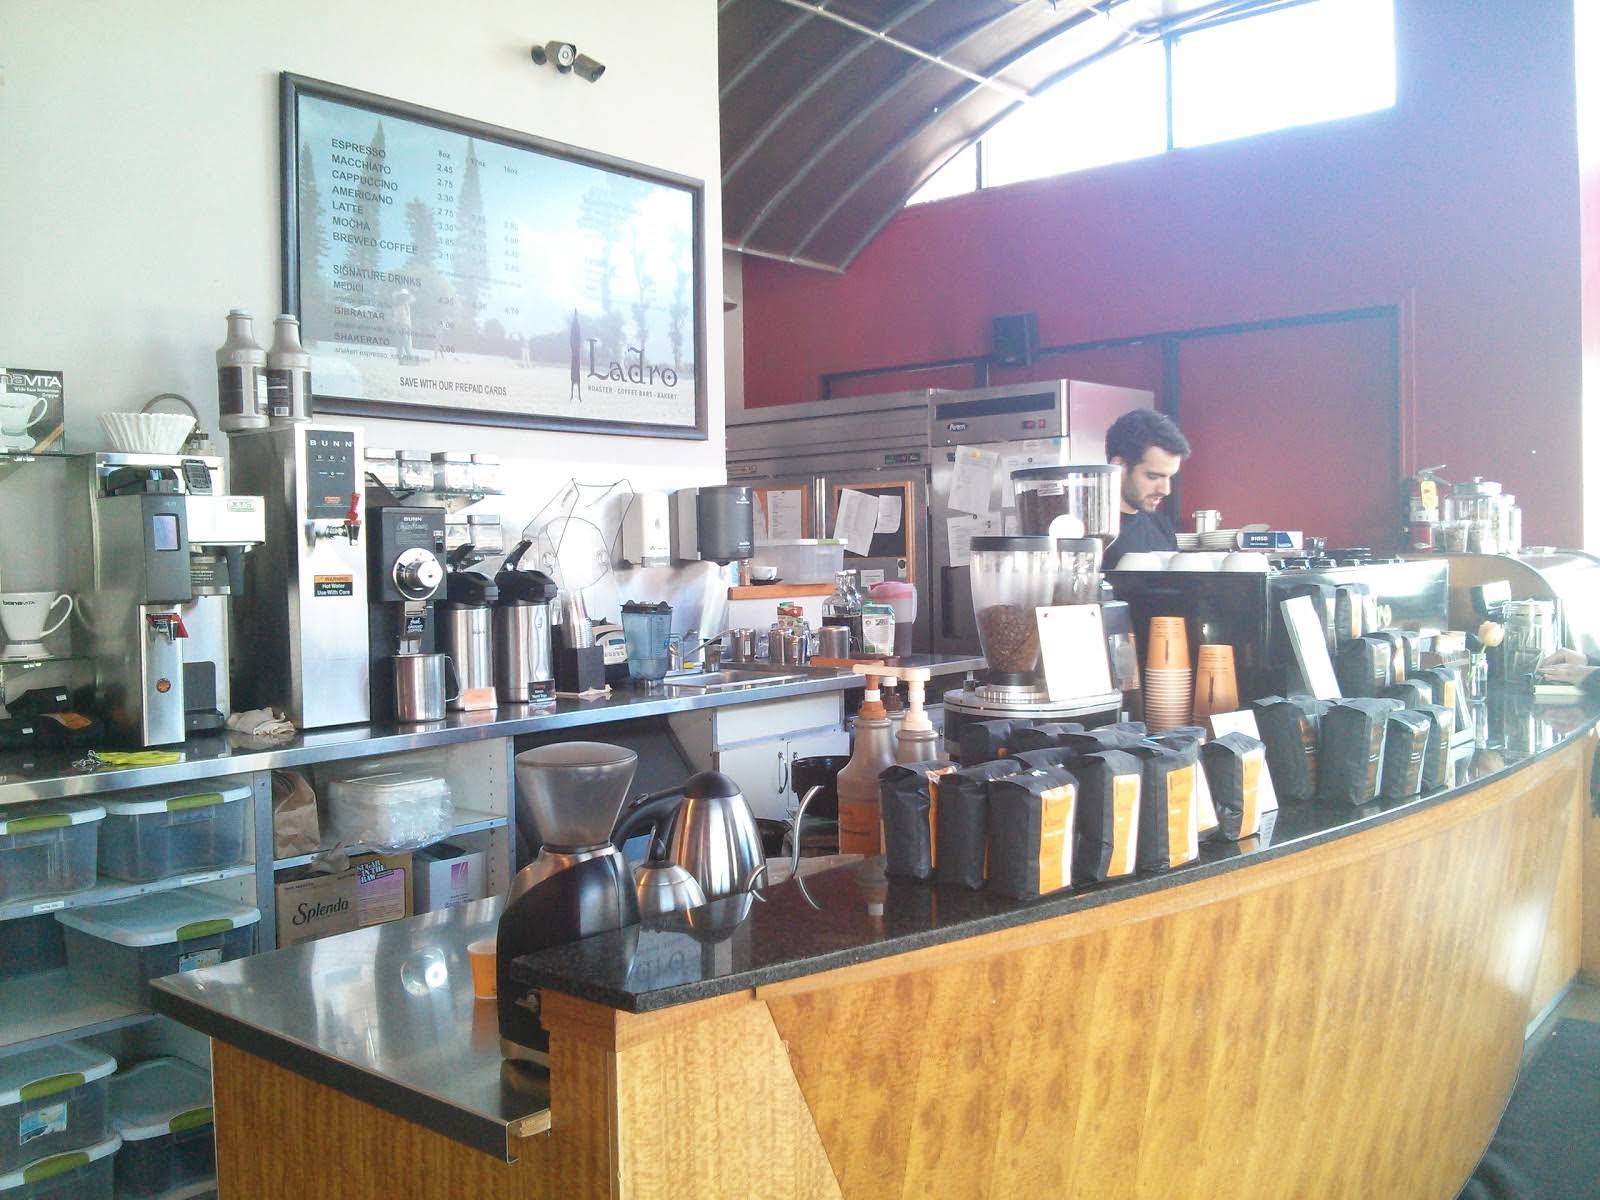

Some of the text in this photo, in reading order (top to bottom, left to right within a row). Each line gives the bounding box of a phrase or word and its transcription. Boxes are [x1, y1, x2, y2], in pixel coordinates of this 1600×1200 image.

[331, 138, 386, 159] ESPRESSO
[331, 154, 391, 175] MACCHIATO
[331, 169, 398, 192] CAPPUCCINO
[331, 185, 393, 205] AMERICANO
[332, 201, 364, 215] LATTE
[332, 215, 371, 232] MOCHA
[332, 231, 418, 255] BREWED COFFEE
[333, 264, 386, 282] SIGNATURE
[388, 273, 422, 288] DRINKS
[333, 280, 364, 293] MEDICI
[334, 306, 385, 321] GIBRALTAR
[334, 332, 390, 346] SHAKERATO
[586, 338, 678, 388] Ladro
[399, 376, 507, 397] SAVE WITH OUR PREPAID CARDS
[587, 385, 613, 394] ROASTER
[617, 388, 638, 396] COFFEE
[657, 392, 678, 400] BAKERY
[309, 439, 353, 448] BUNN
[292, 897, 349, 926] Splenda
